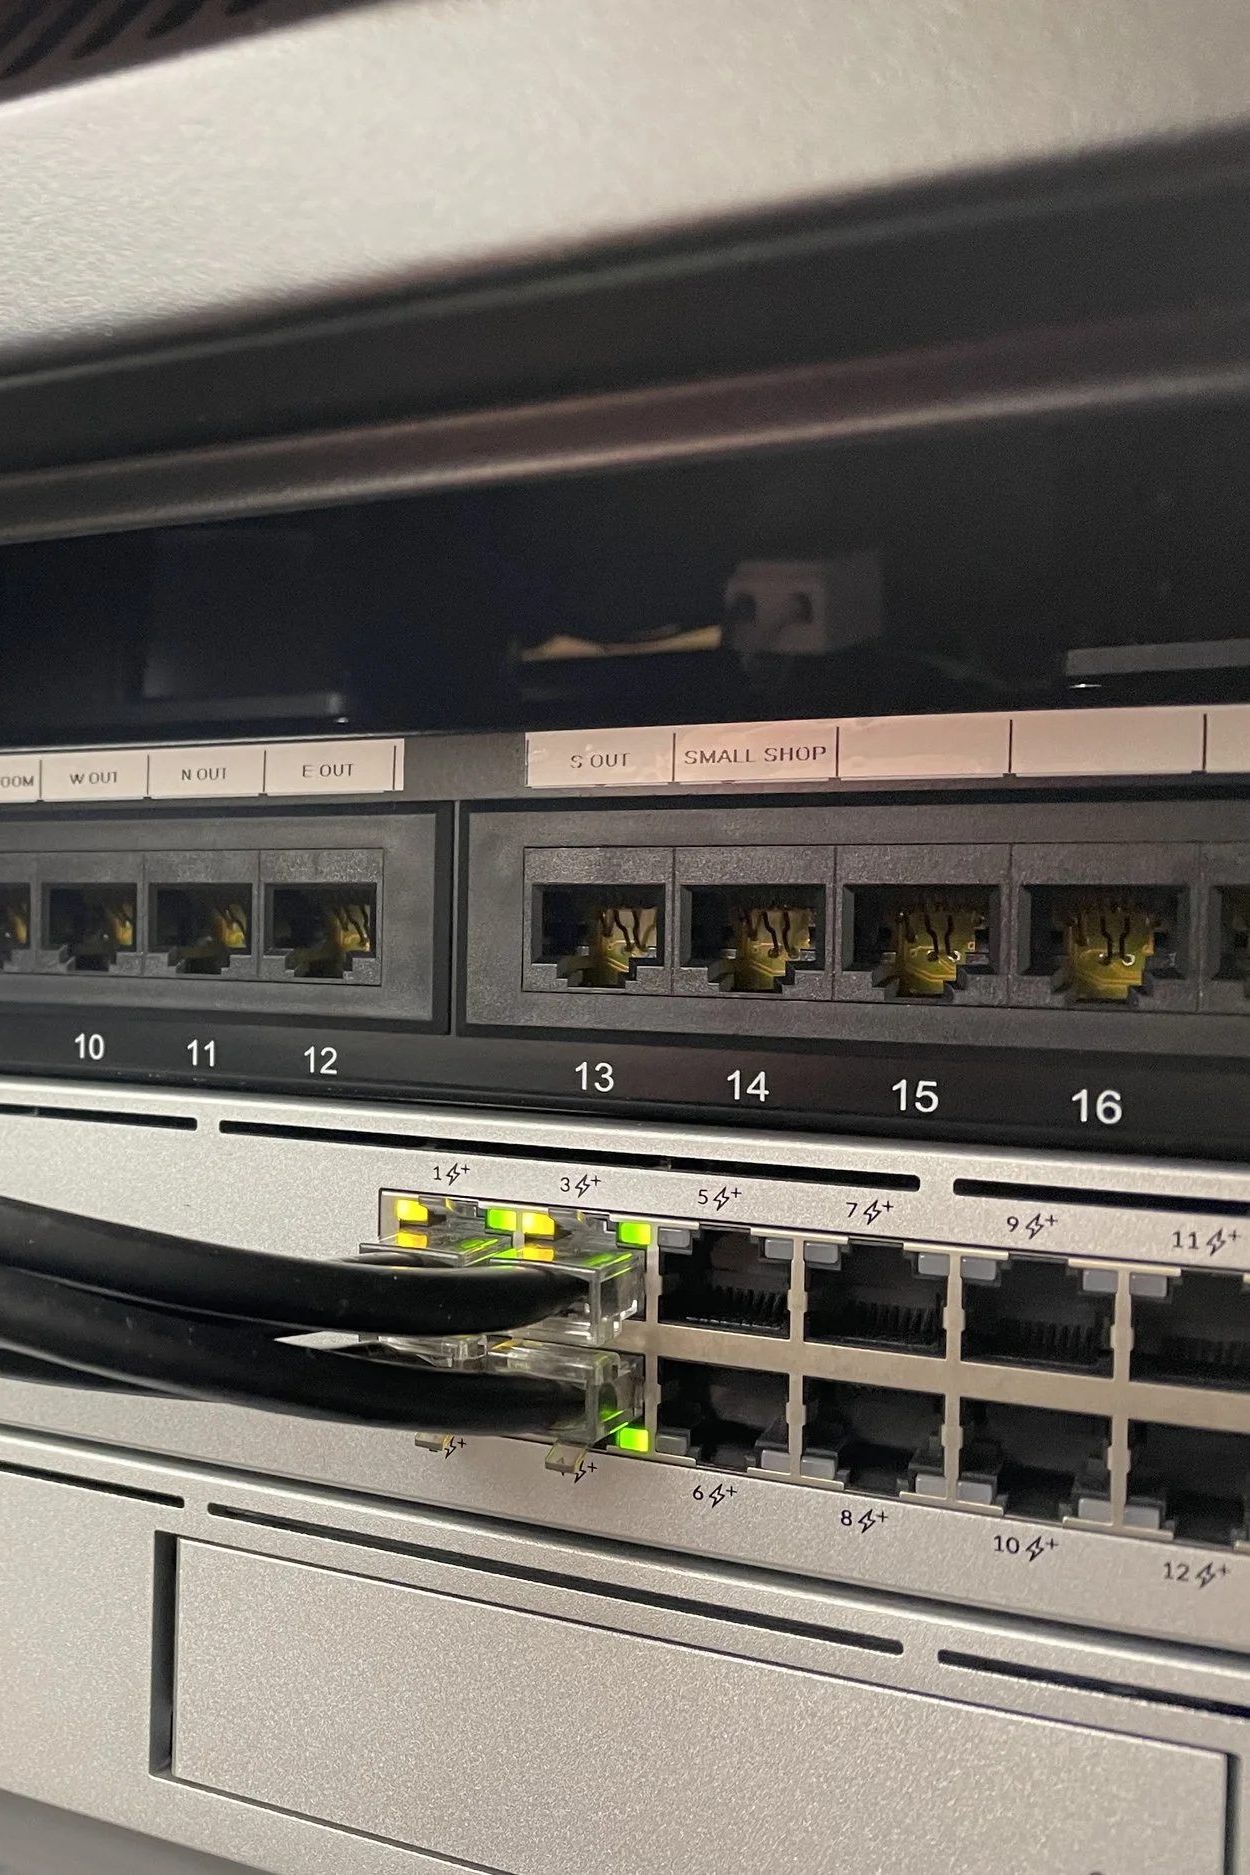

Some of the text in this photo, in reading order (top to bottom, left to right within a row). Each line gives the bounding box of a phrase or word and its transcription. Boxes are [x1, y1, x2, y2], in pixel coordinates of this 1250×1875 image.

[570, 752, 630, 769] S OUT
[684, 746, 827, 765] SMALL SHOP
[69, 771, 118, 785] W OUT
[181, 766, 227, 781] N OUT
[302, 763, 354, 778] E OUT
[74, 1032, 105, 1061] 10
[187, 1039, 216, 1068] 11
[303, 1045, 338, 1075] 12
[575, 1061, 616, 1093] 13
[726, 1069, 770, 1102] 14
[892, 1079, 940, 1113] 15
[1071, 1088, 1123, 1125] 16
